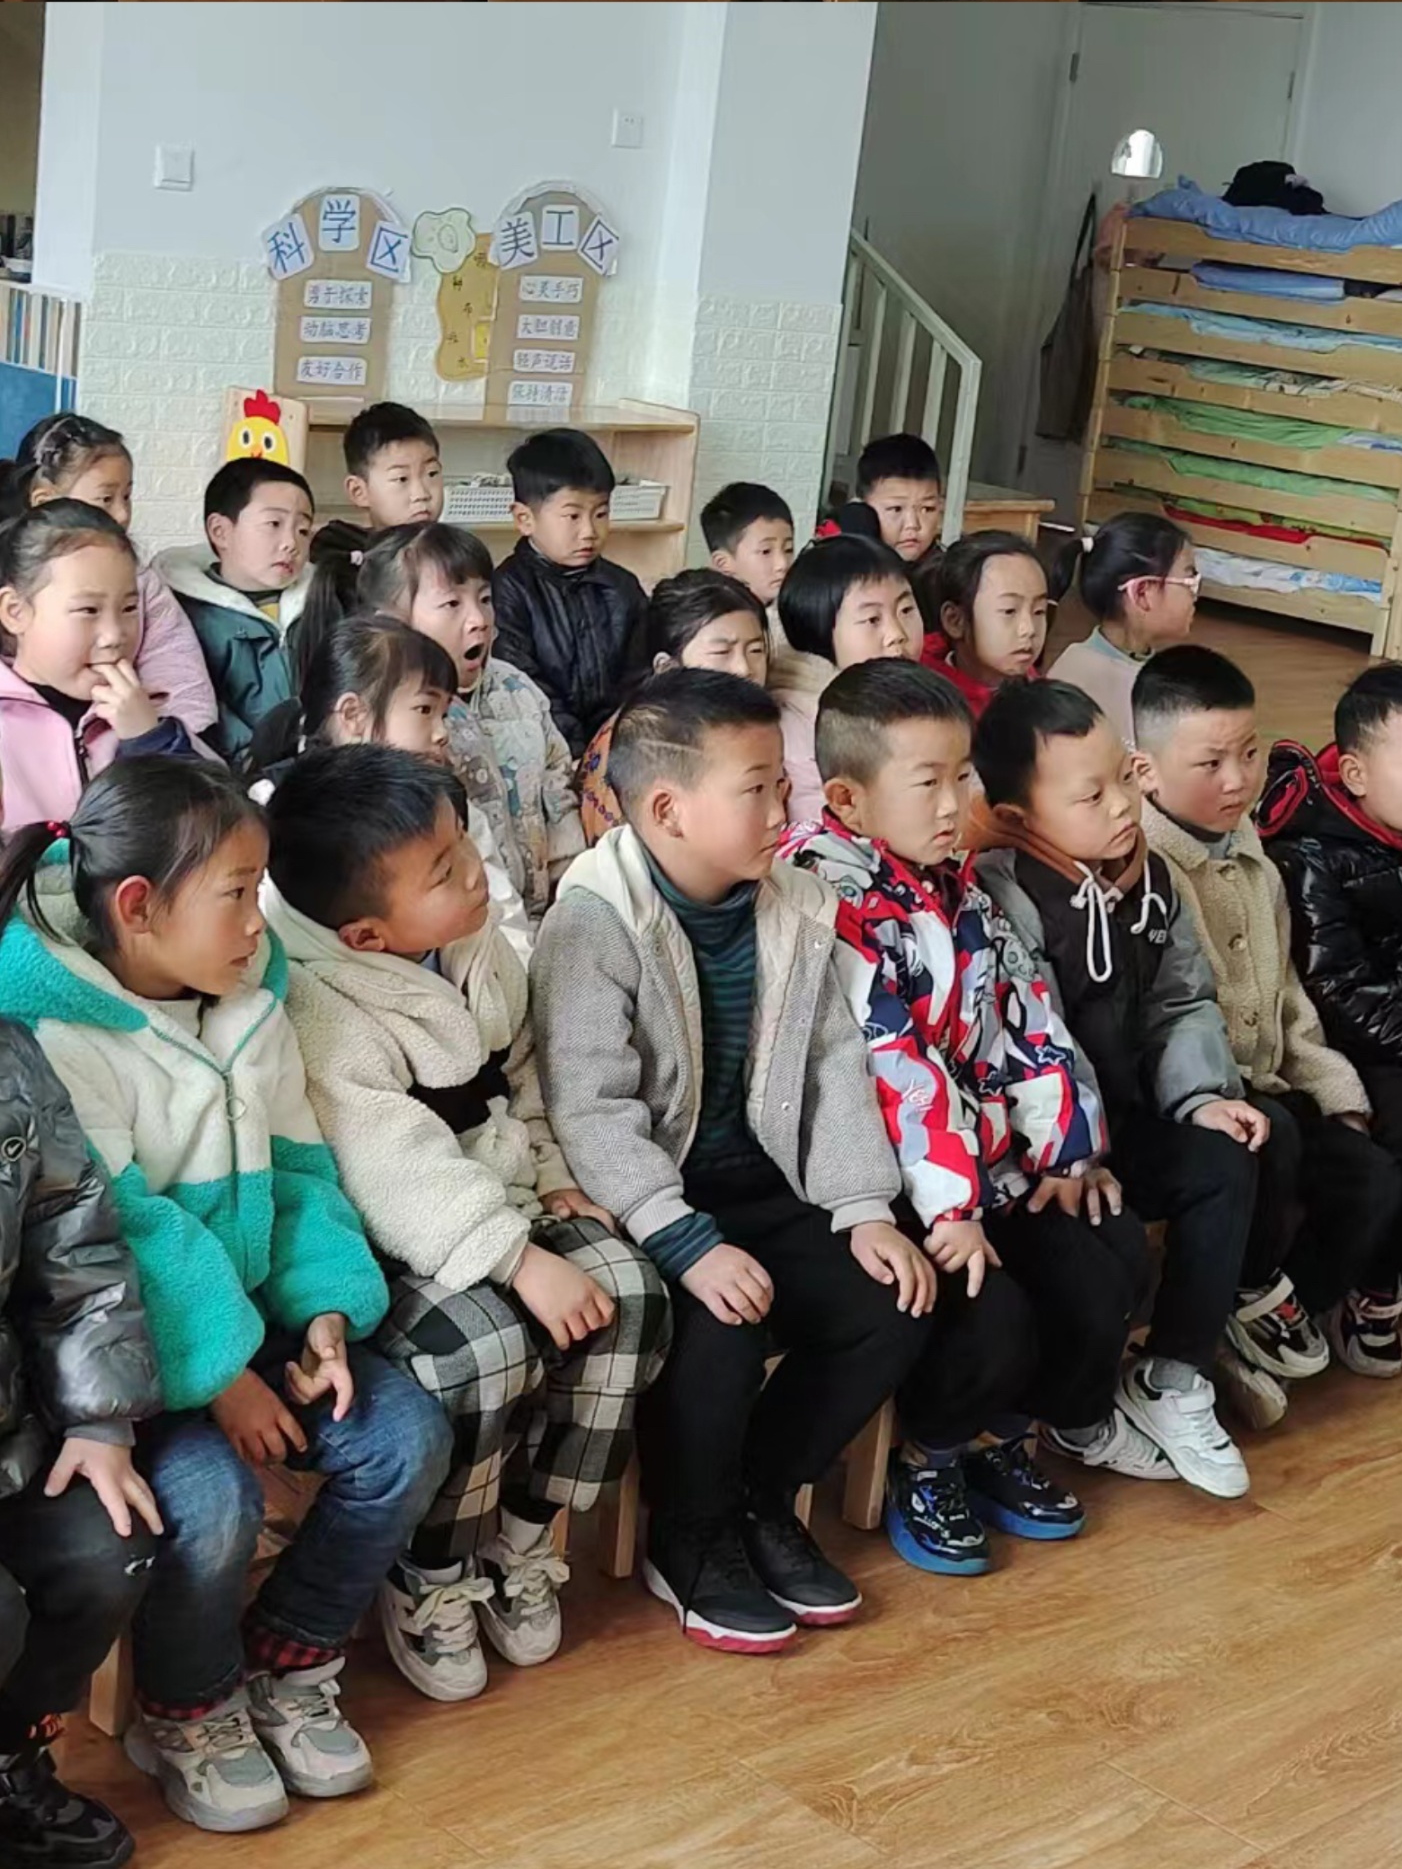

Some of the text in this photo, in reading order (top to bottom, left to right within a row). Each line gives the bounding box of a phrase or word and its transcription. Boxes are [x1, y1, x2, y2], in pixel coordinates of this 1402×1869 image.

[267, 199, 409, 273] 科学区
[500, 209, 620, 270] 美工区
[303, 320, 368, 341] 动脑思考
[300, 359, 364, 381] 友好合作
